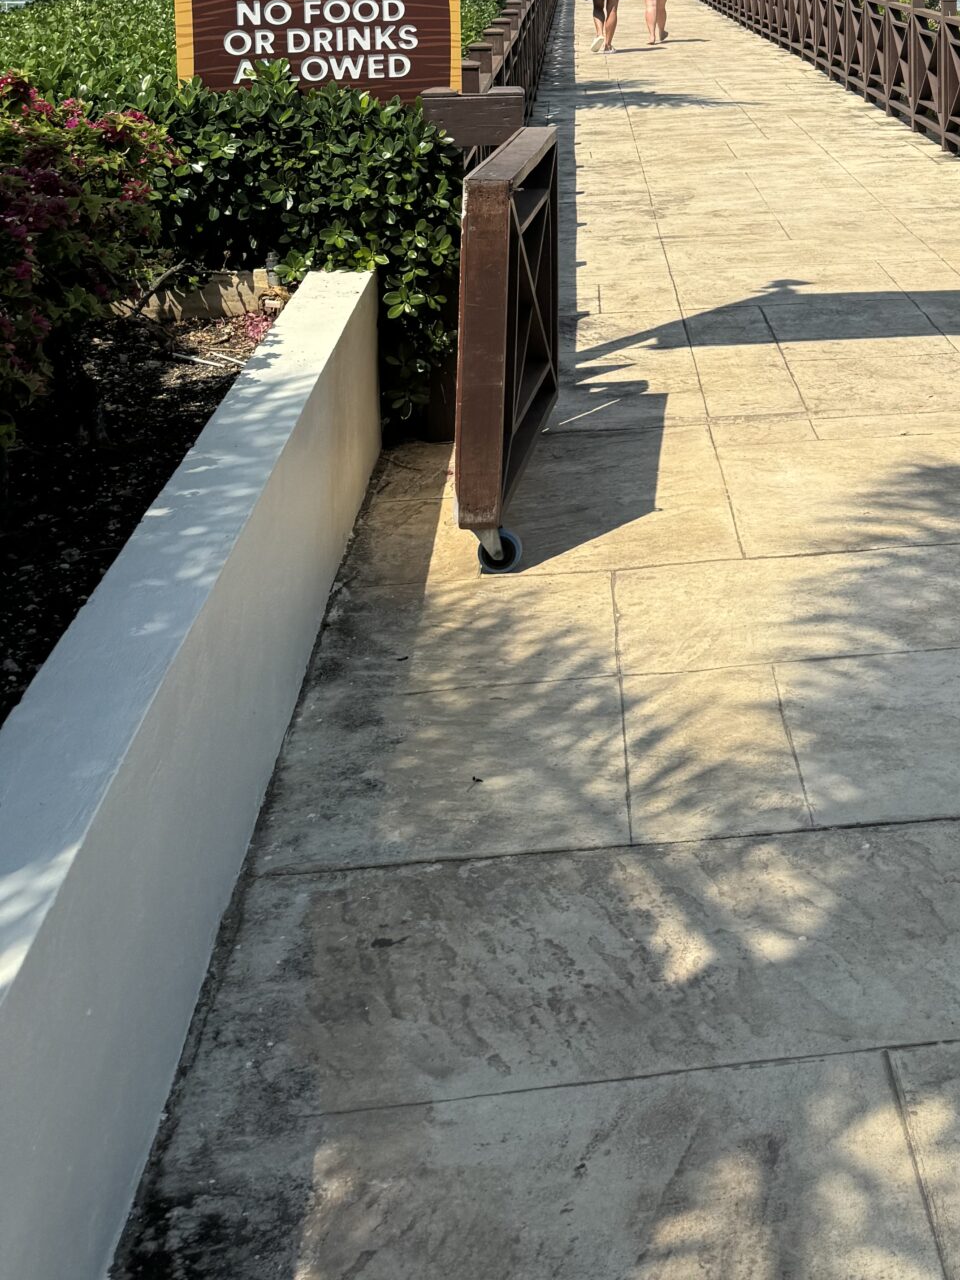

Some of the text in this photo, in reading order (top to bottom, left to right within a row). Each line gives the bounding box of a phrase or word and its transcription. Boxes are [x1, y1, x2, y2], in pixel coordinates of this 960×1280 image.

[223, 24, 419, 57] OR DRINKS
[233, 53, 411, 85] AOWED
